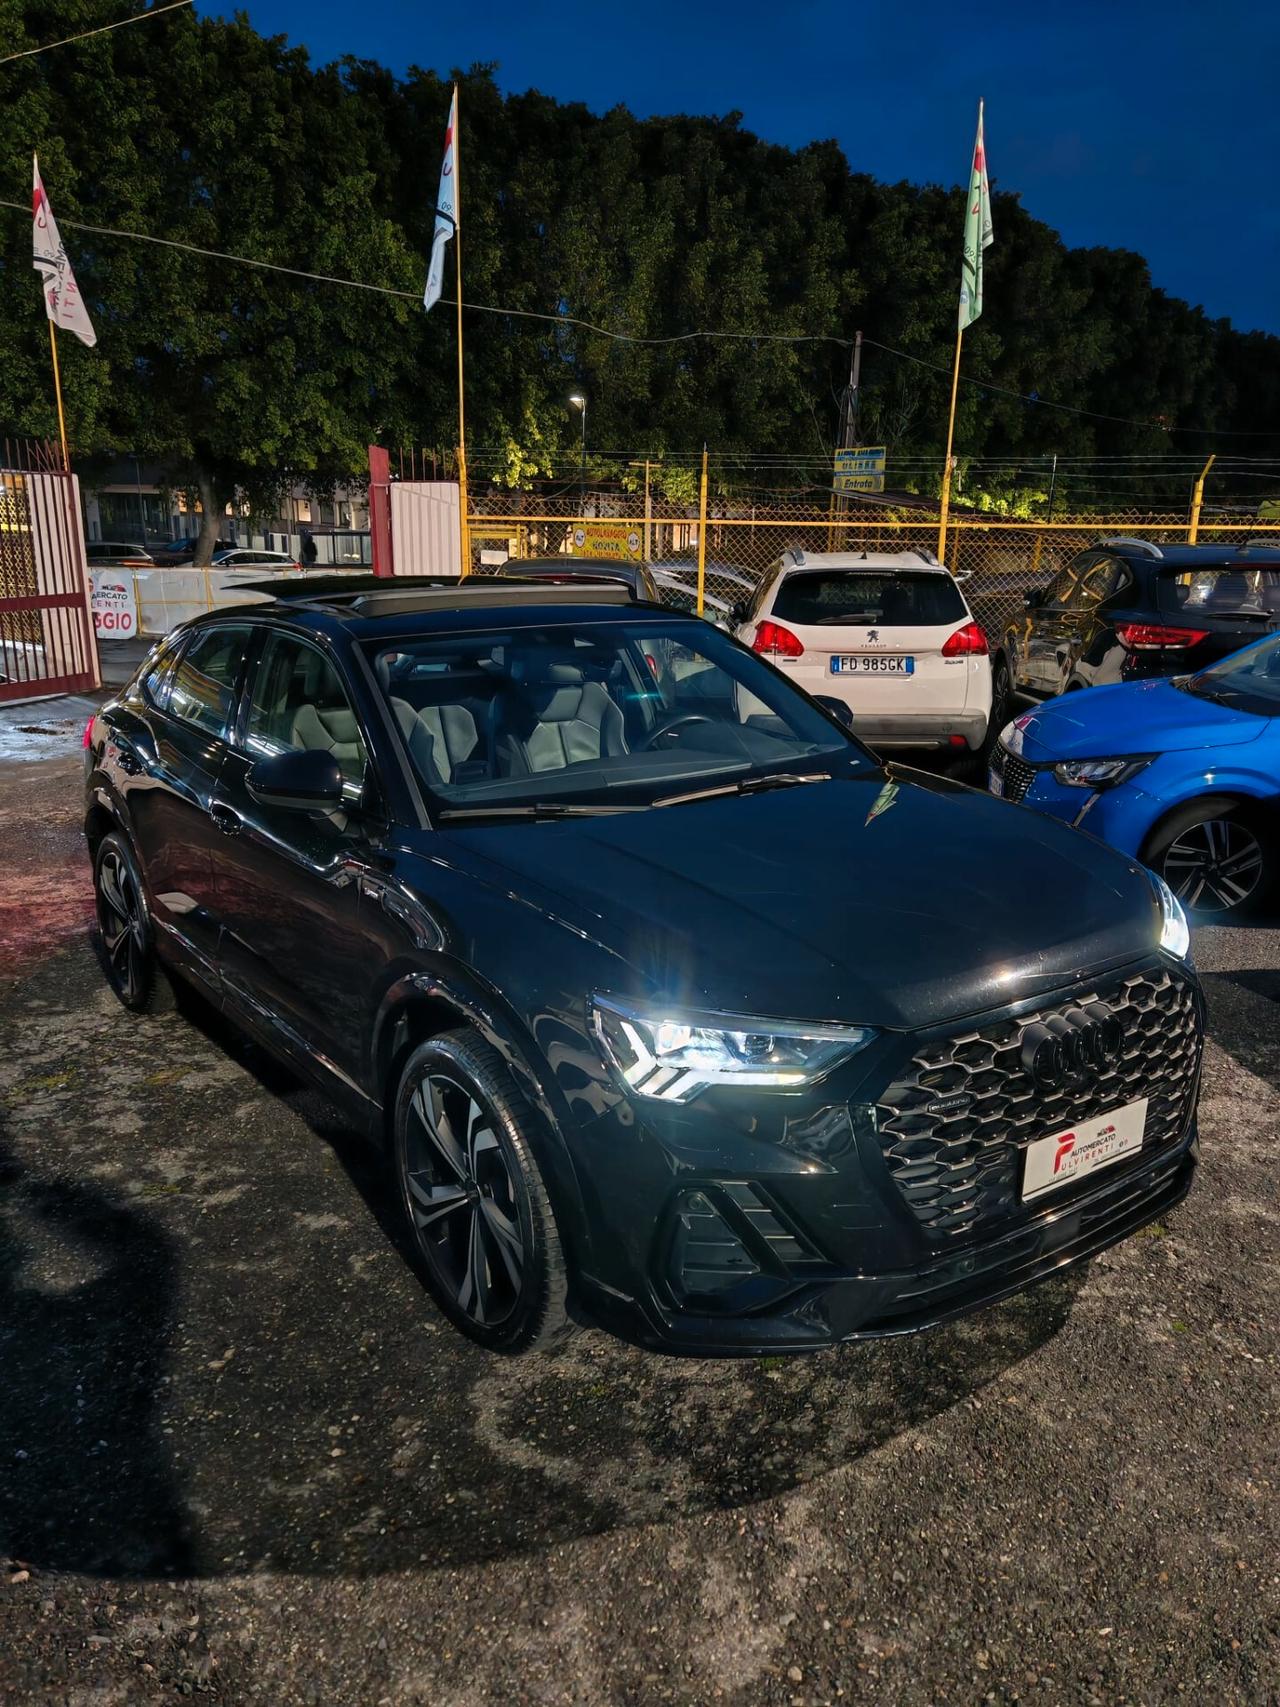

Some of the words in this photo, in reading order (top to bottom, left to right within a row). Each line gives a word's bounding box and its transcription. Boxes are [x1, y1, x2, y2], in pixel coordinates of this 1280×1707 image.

[844, 478, 873, 489] Entrata
[841, 657, 858, 671] FD
[863, 657, 904, 671] 985GK
[1071, 1133, 1117, 1158] AUTOMERCATO
